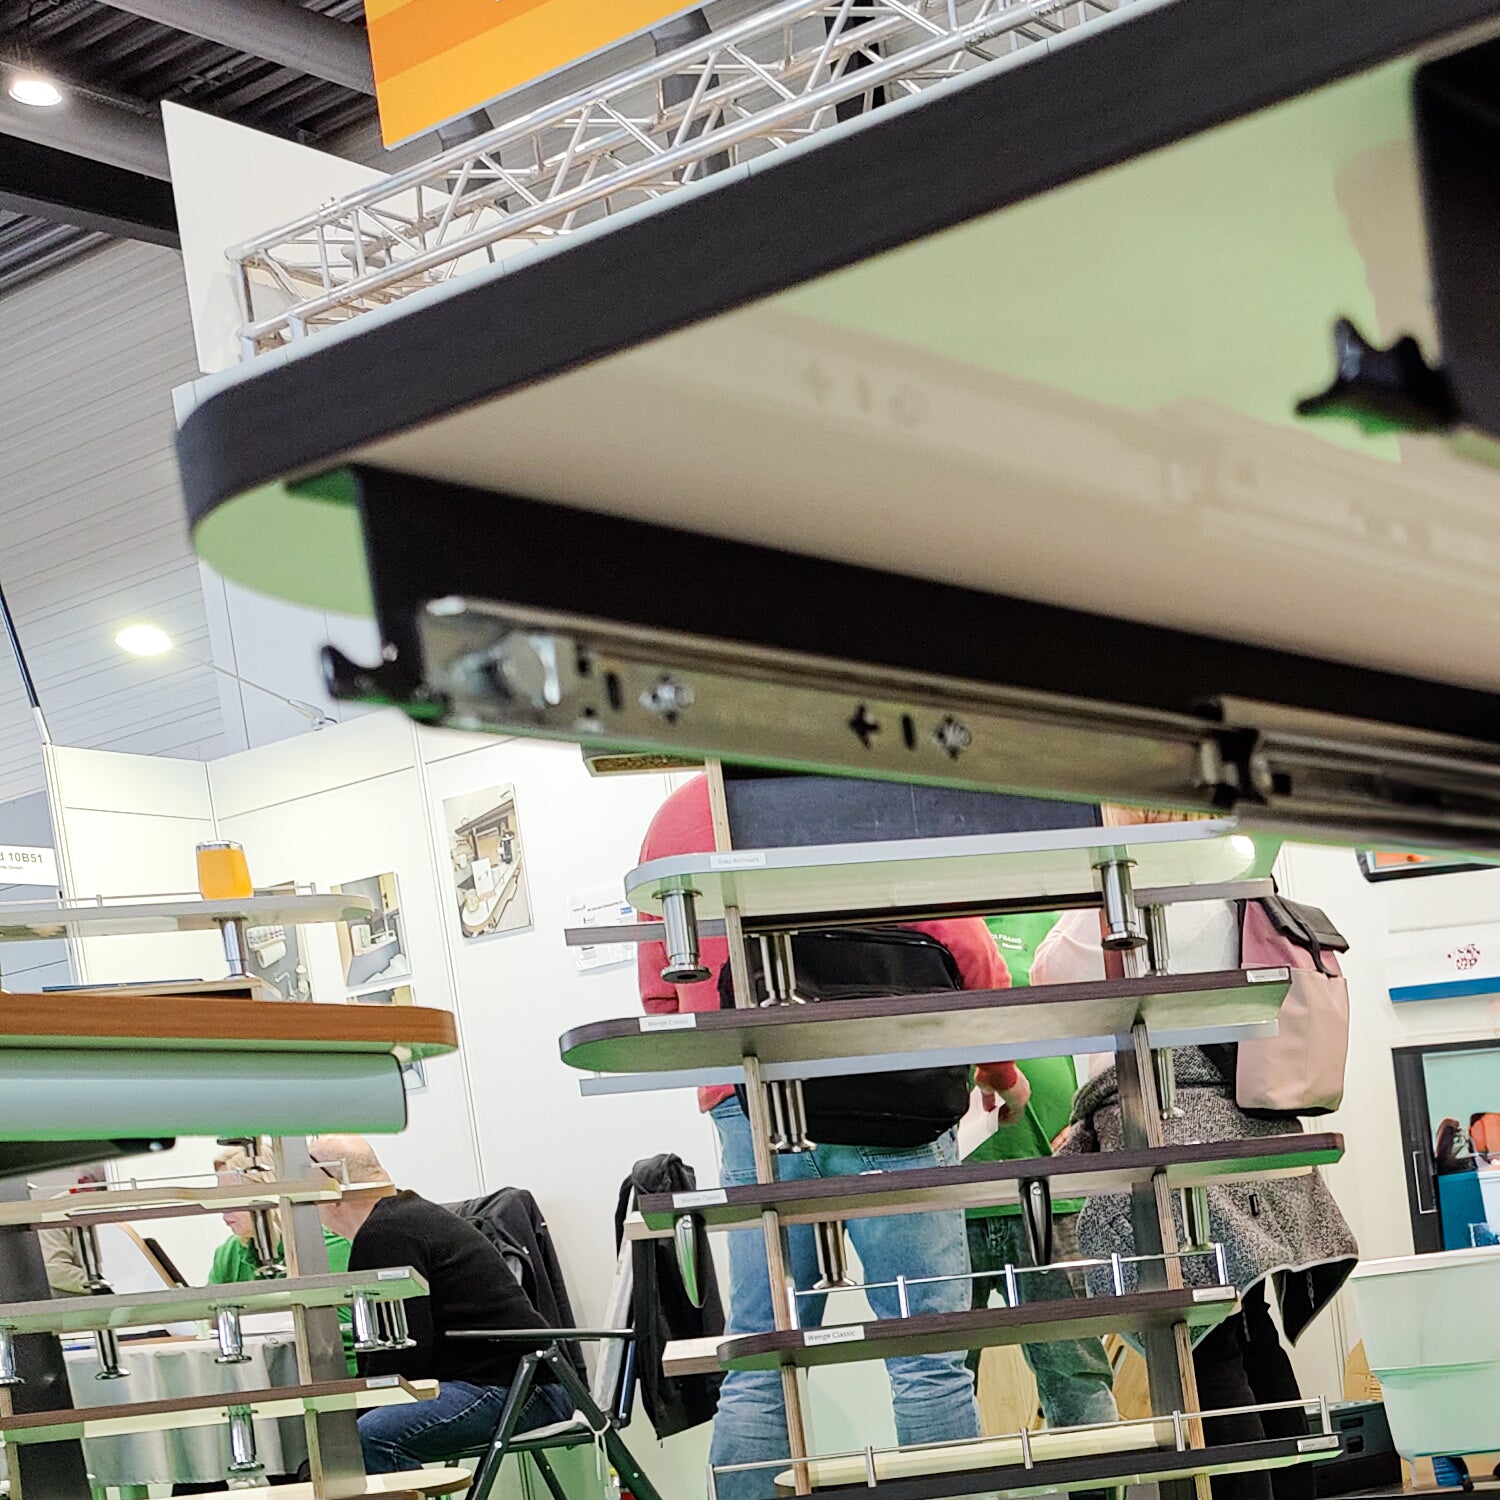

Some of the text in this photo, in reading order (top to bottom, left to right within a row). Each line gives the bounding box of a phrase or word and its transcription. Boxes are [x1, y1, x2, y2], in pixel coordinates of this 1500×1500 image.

[8, 852, 43, 864] 10B51
[807, 1329, 856, 1341] Wenge Classic
